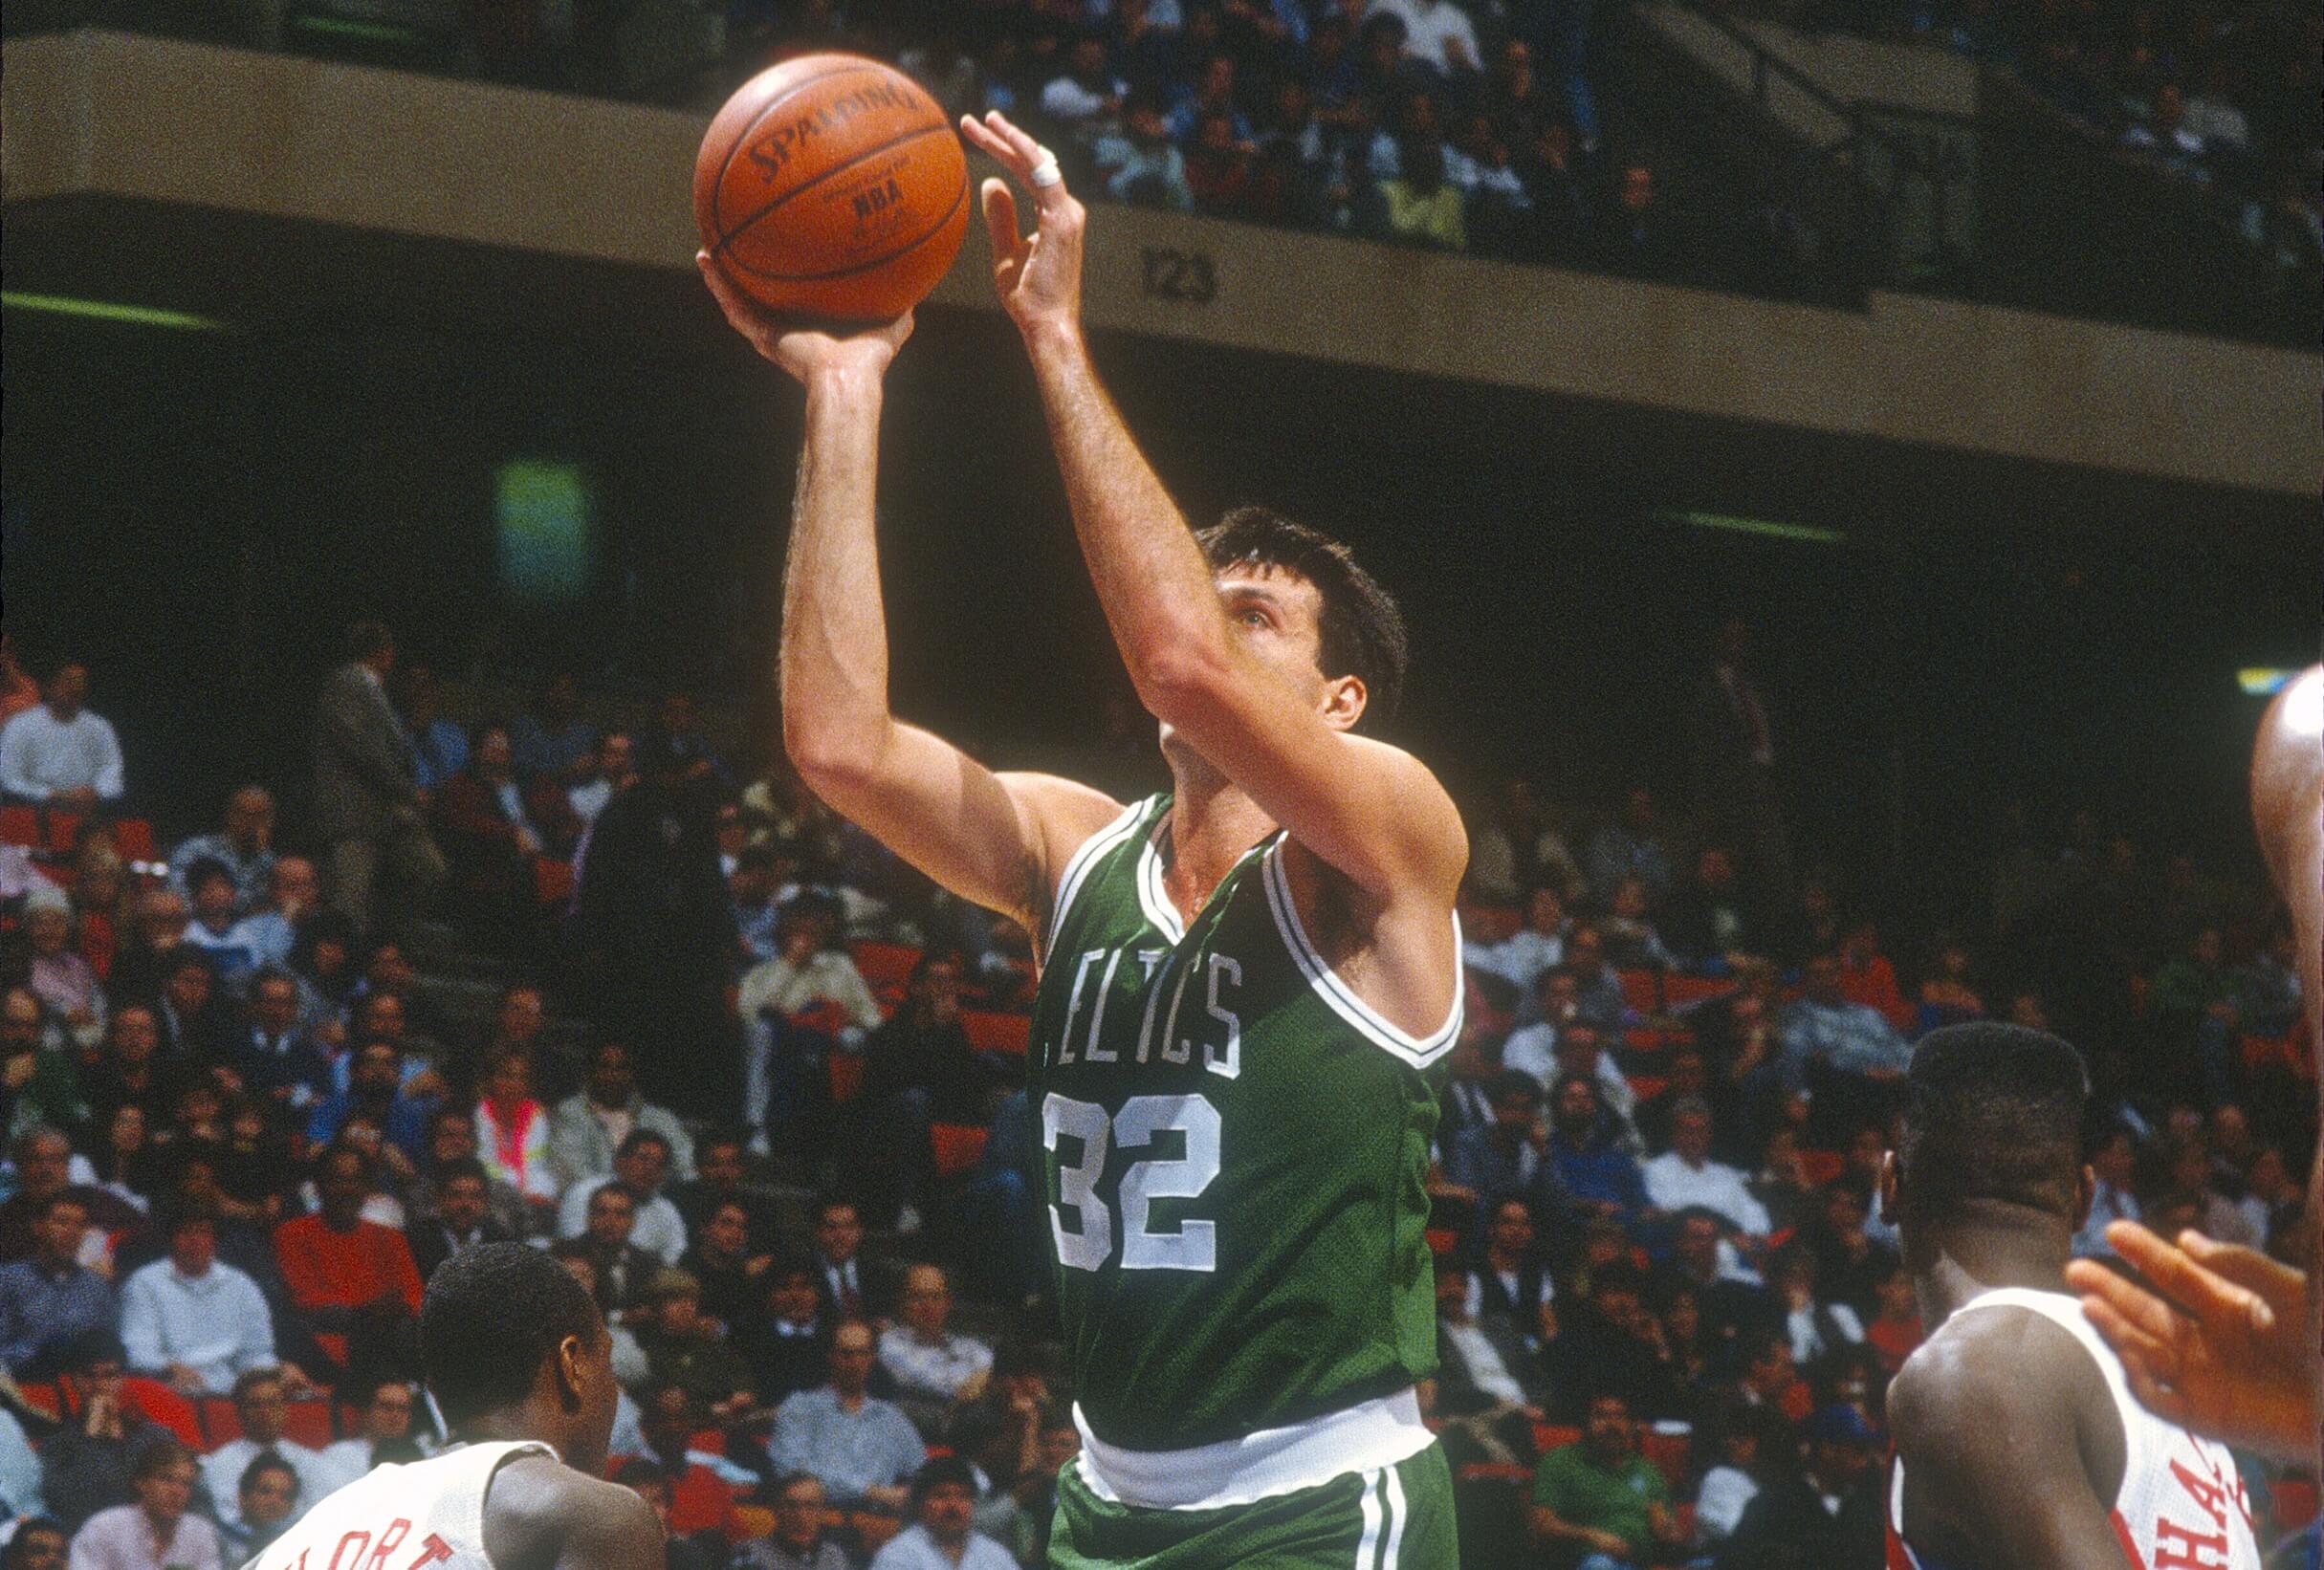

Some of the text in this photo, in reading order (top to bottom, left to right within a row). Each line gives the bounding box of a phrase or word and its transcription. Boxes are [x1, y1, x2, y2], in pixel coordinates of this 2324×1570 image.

[852, 179, 902, 220] NBA
[1143, 246, 1216, 302] 123
[1042, 1092, 1221, 1272] 32
[284, 1517, 453, 1570] ORT
